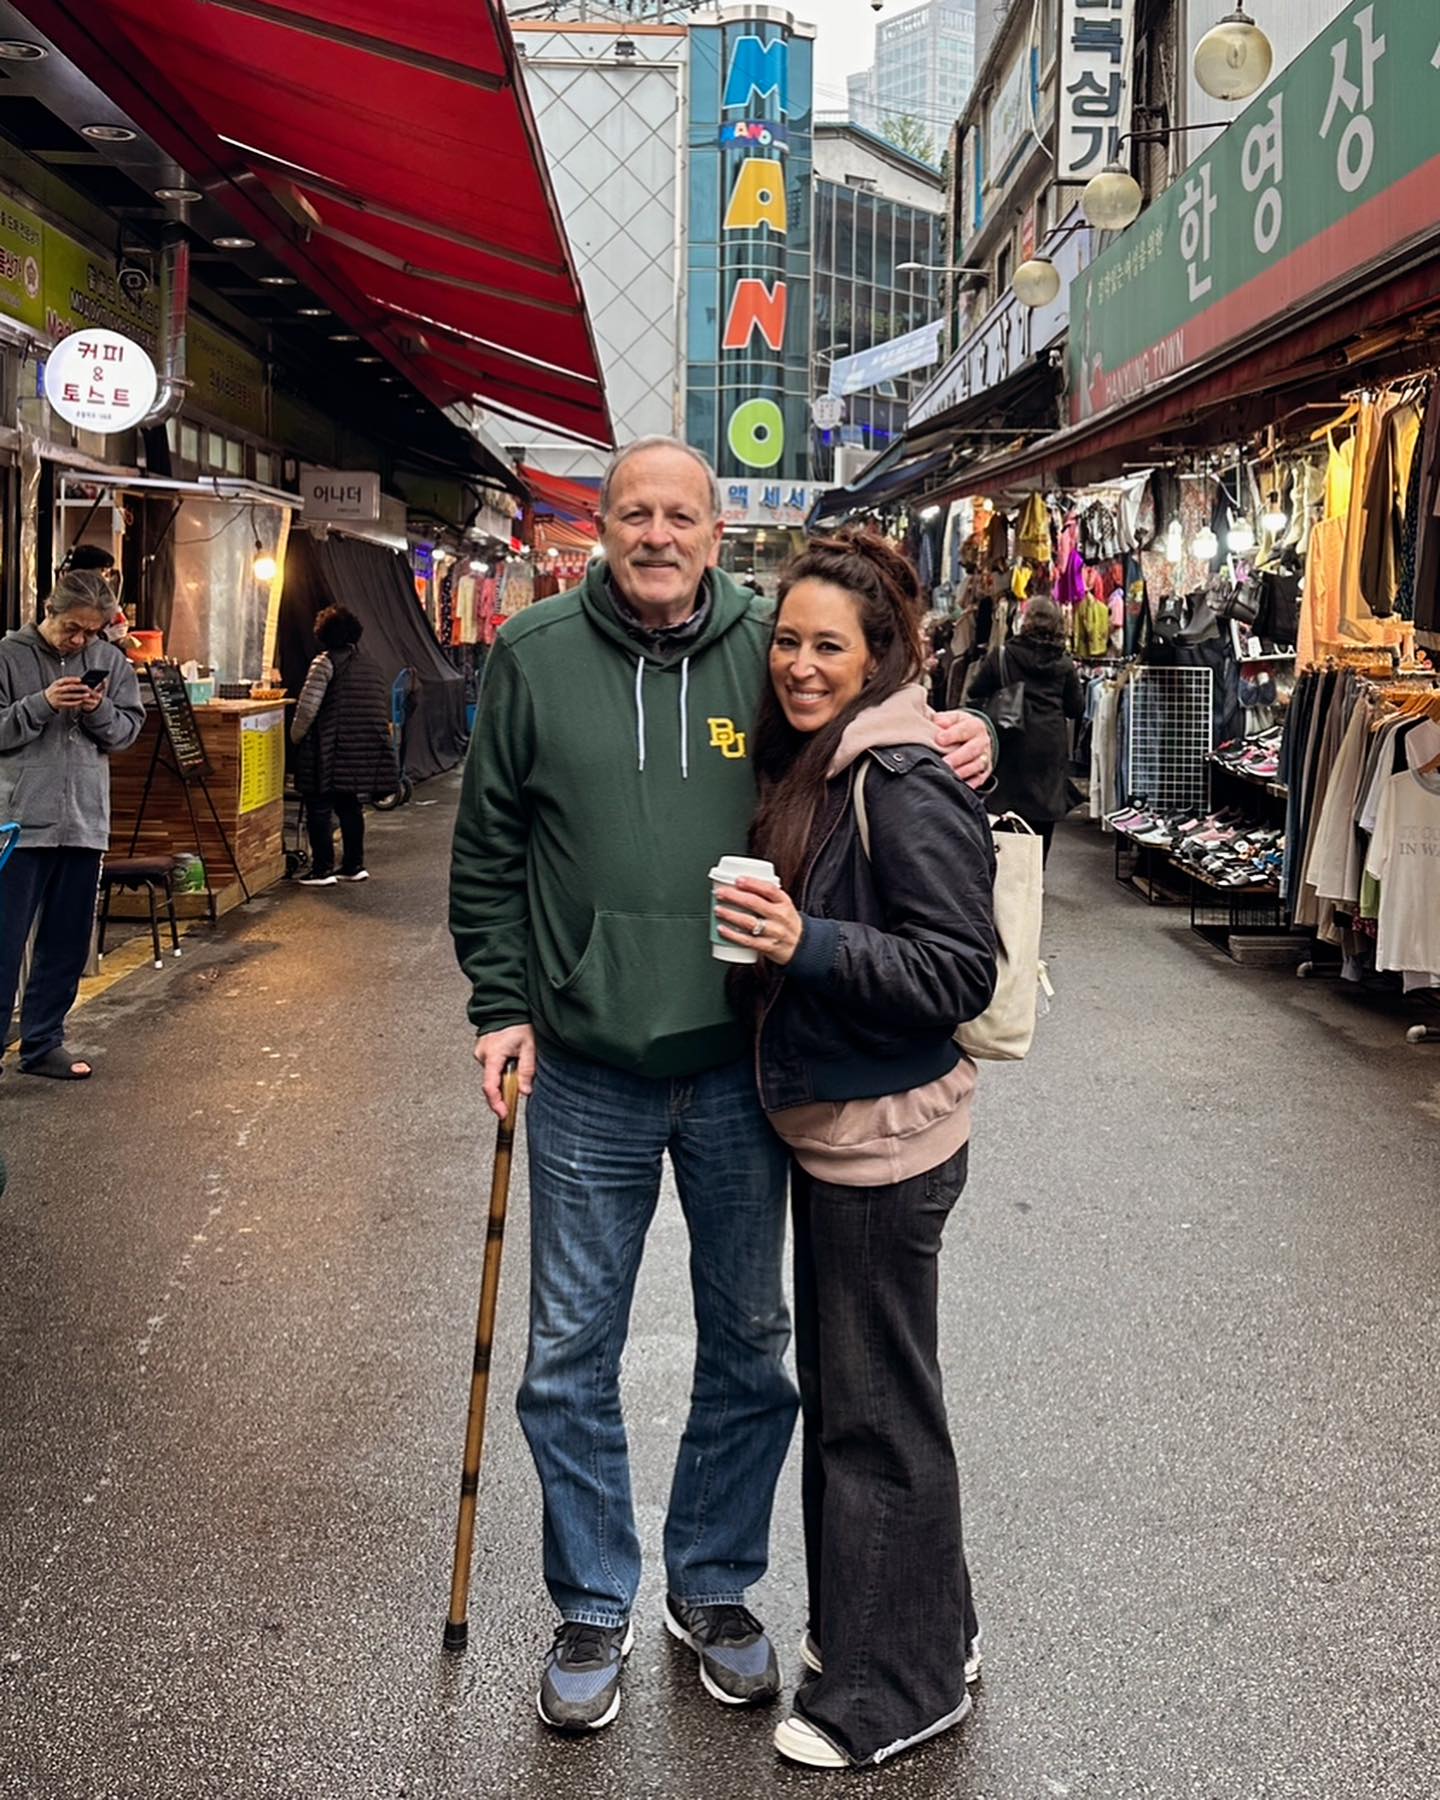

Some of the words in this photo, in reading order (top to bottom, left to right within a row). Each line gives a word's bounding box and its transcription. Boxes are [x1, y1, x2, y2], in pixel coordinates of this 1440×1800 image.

[720, 121, 773, 146] MANO
[1178, 4, 1440, 303] 한영상
[721, 35, 789, 470] MANO
[78, 341, 125, 363] 커피
[1152, 327, 1185, 380] TOWN
[92, 365, 104, 382] &
[62, 383, 131, 408] 토스트
[313, 485, 362, 503] 어나더
[706, 717, 747, 759] BU
[1400, 842, 1417, 855] IN
